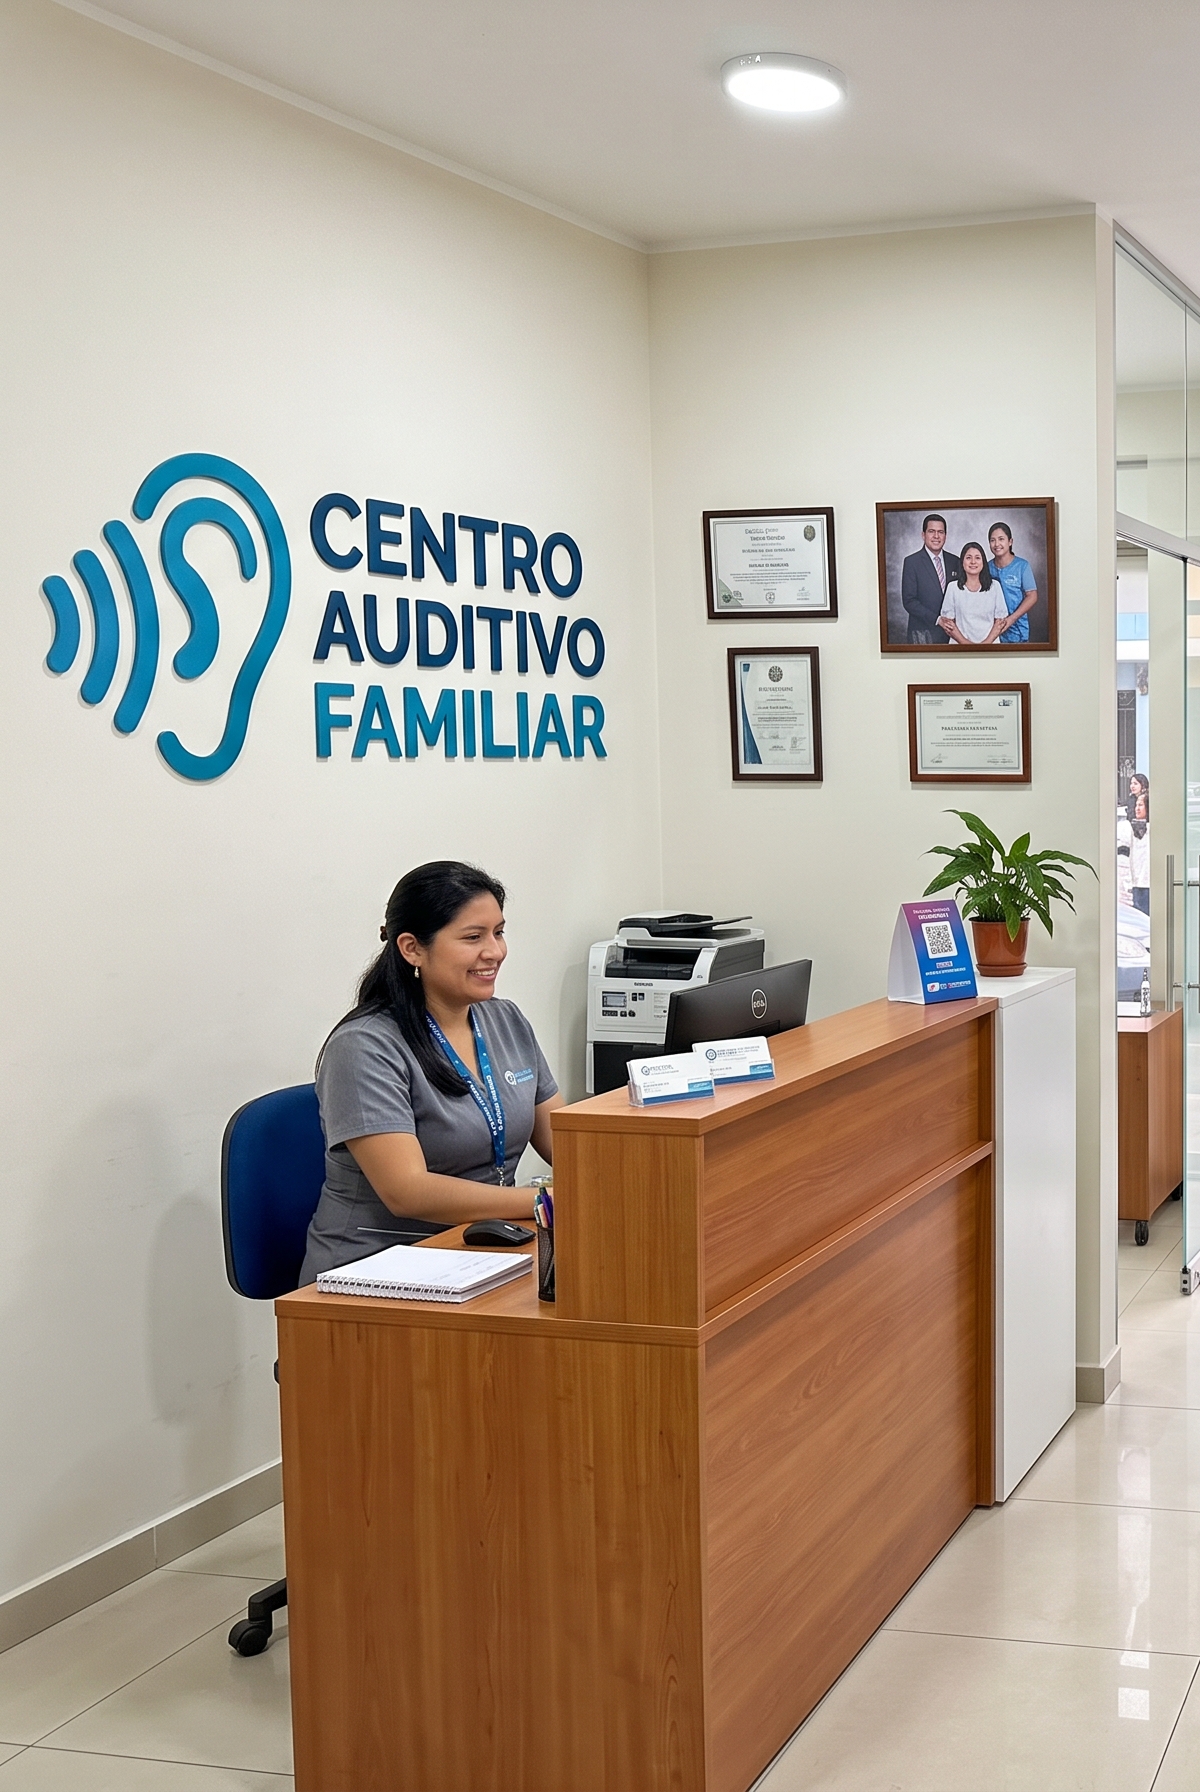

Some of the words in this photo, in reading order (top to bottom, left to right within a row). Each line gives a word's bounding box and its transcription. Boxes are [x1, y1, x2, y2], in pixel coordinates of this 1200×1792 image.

[310, 493, 583, 598] CENTRO
[313, 591, 605, 678] AUDITIVO
[314, 682, 607, 758] FAMILIAR
